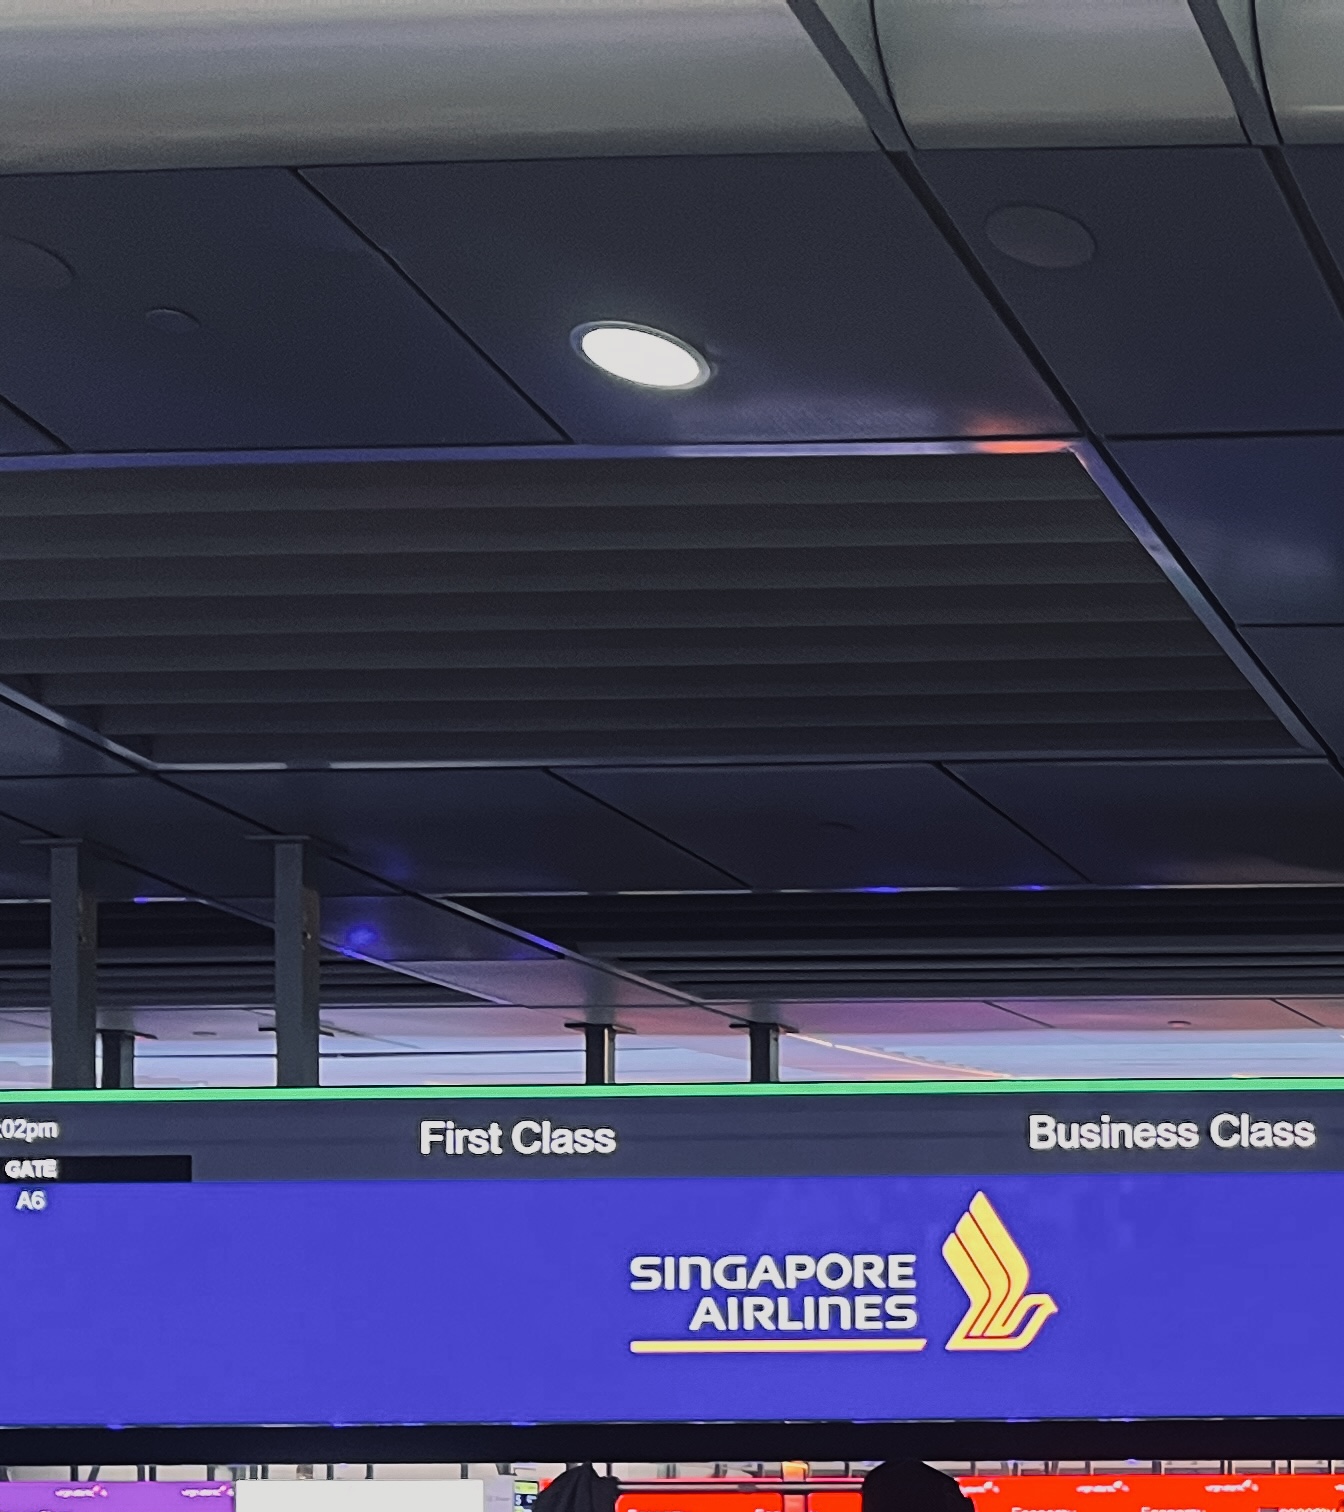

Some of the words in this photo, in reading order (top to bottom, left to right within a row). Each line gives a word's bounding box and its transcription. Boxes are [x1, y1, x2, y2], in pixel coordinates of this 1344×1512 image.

[420, 1120, 503, 1155] First
[511, 1119, 617, 1155] Class
[1028, 1114, 1200, 1150] Business
[1209, 1112, 1316, 1148] Class
[4, 1158, 59, 1180] GATE
[15, 1190, 47, 1211] A6
[629, 1252, 918, 1291] SINGAPORE
[688, 1295, 918, 1331] AIRLINES
